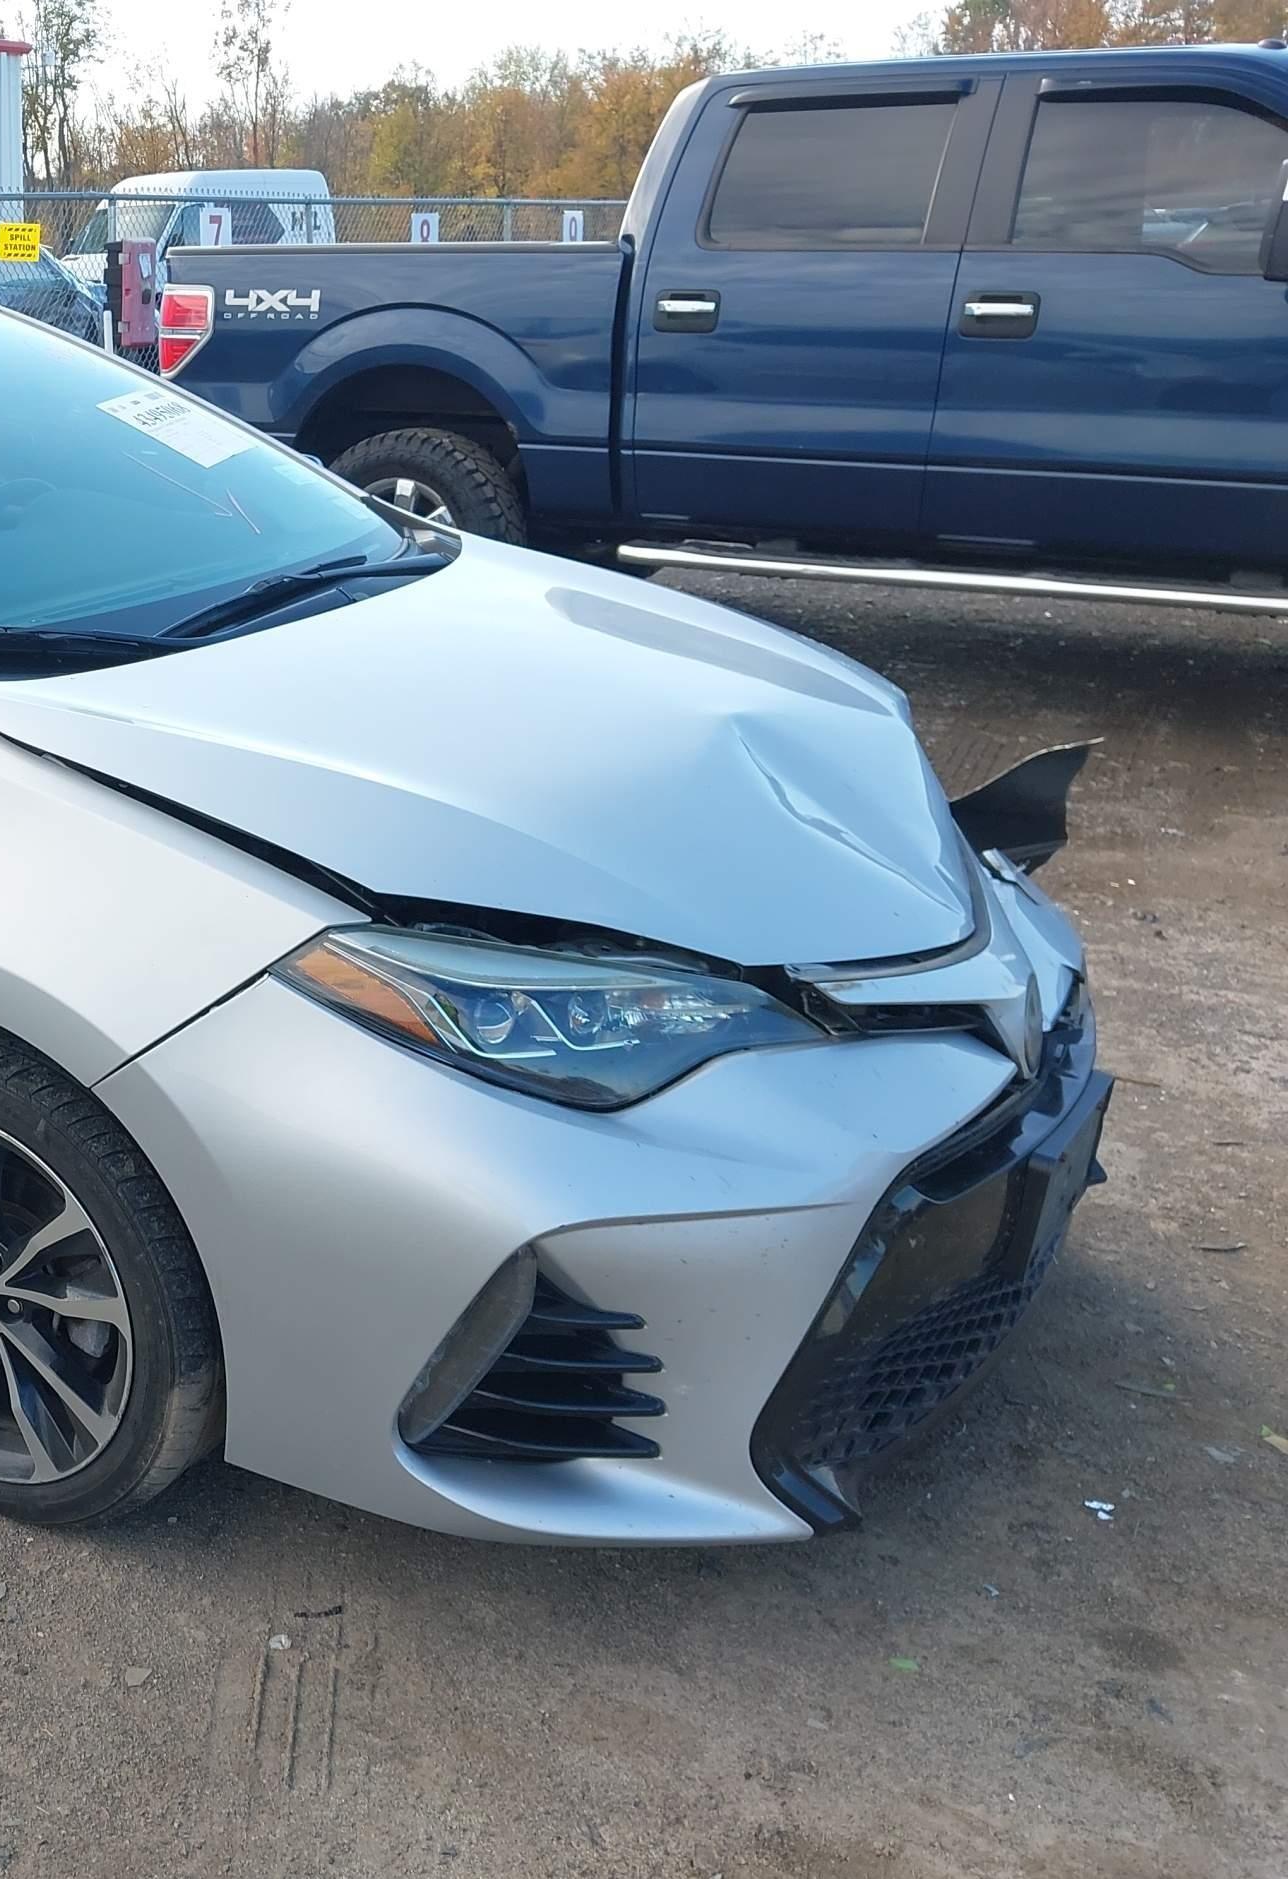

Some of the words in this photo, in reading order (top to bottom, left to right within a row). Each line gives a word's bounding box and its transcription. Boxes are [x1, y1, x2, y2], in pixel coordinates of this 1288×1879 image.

[209, 214, 223, 246] 7
[9, 233, 32, 242] SPILL
[3, 243, 36, 251] STATION
[224, 289, 321, 312] 4X4
[223, 312, 258, 320] OFF
[266, 312, 319, 320] ROAD
